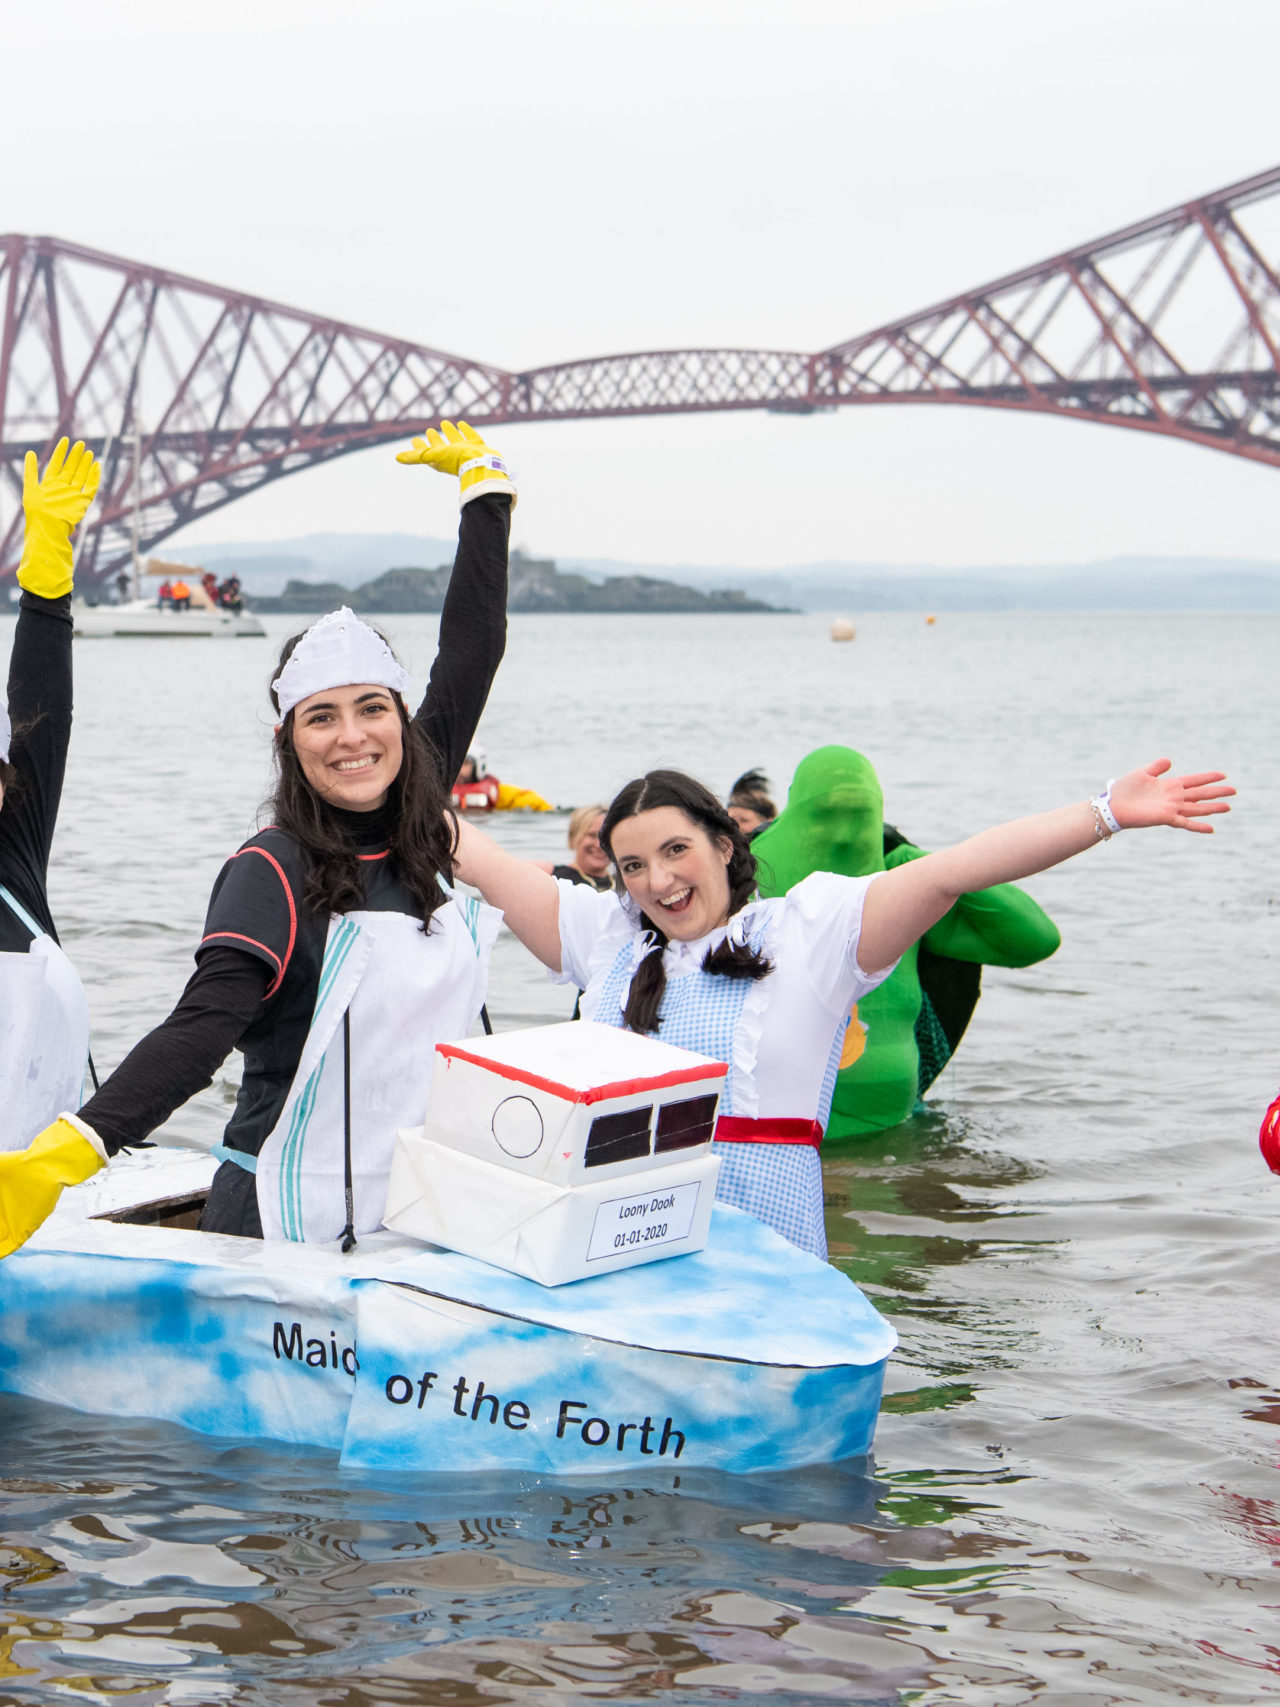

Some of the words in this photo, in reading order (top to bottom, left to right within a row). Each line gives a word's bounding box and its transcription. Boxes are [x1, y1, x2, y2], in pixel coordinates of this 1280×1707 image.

[619, 1203, 649, 1220] Loony
[650, 1194, 676, 1212] Dook
[614, 1223, 668, 1248] 01-01-2020
[385, 1372, 438, 1409] of
[453, 1376, 531, 1430] the
[556, 1400, 686, 1458] Forth
